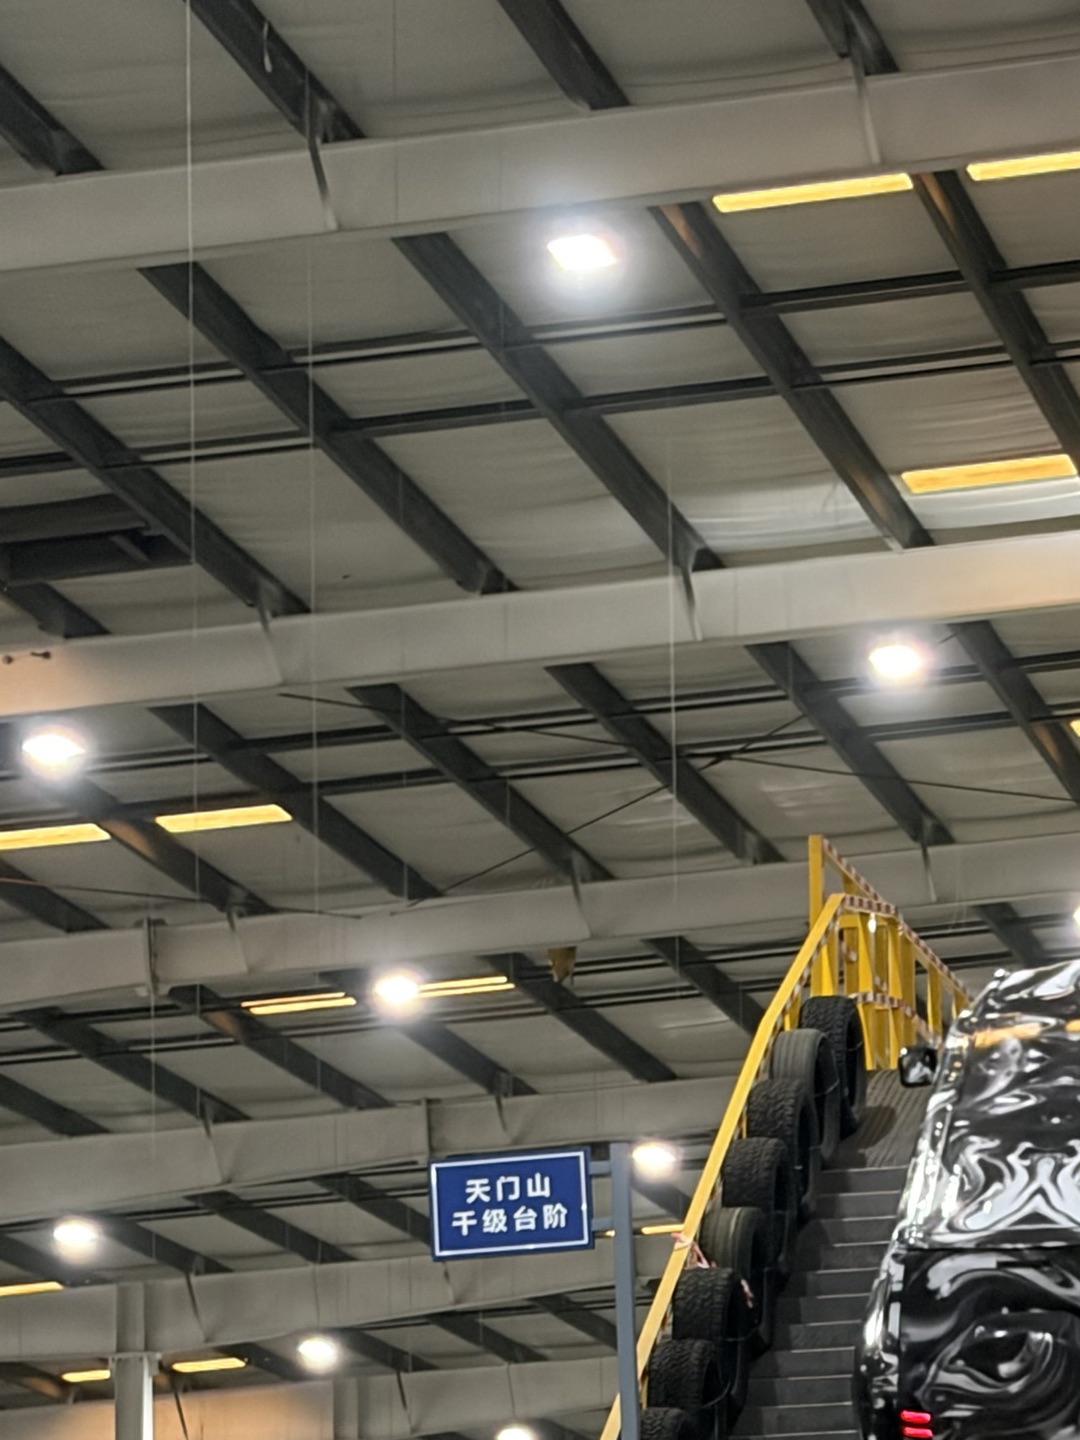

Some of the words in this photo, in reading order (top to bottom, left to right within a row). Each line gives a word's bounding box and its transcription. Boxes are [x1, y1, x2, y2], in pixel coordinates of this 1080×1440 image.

[465, 1172, 551, 1204] 天门山
[452, 1203, 568, 1236] 千级台阶
